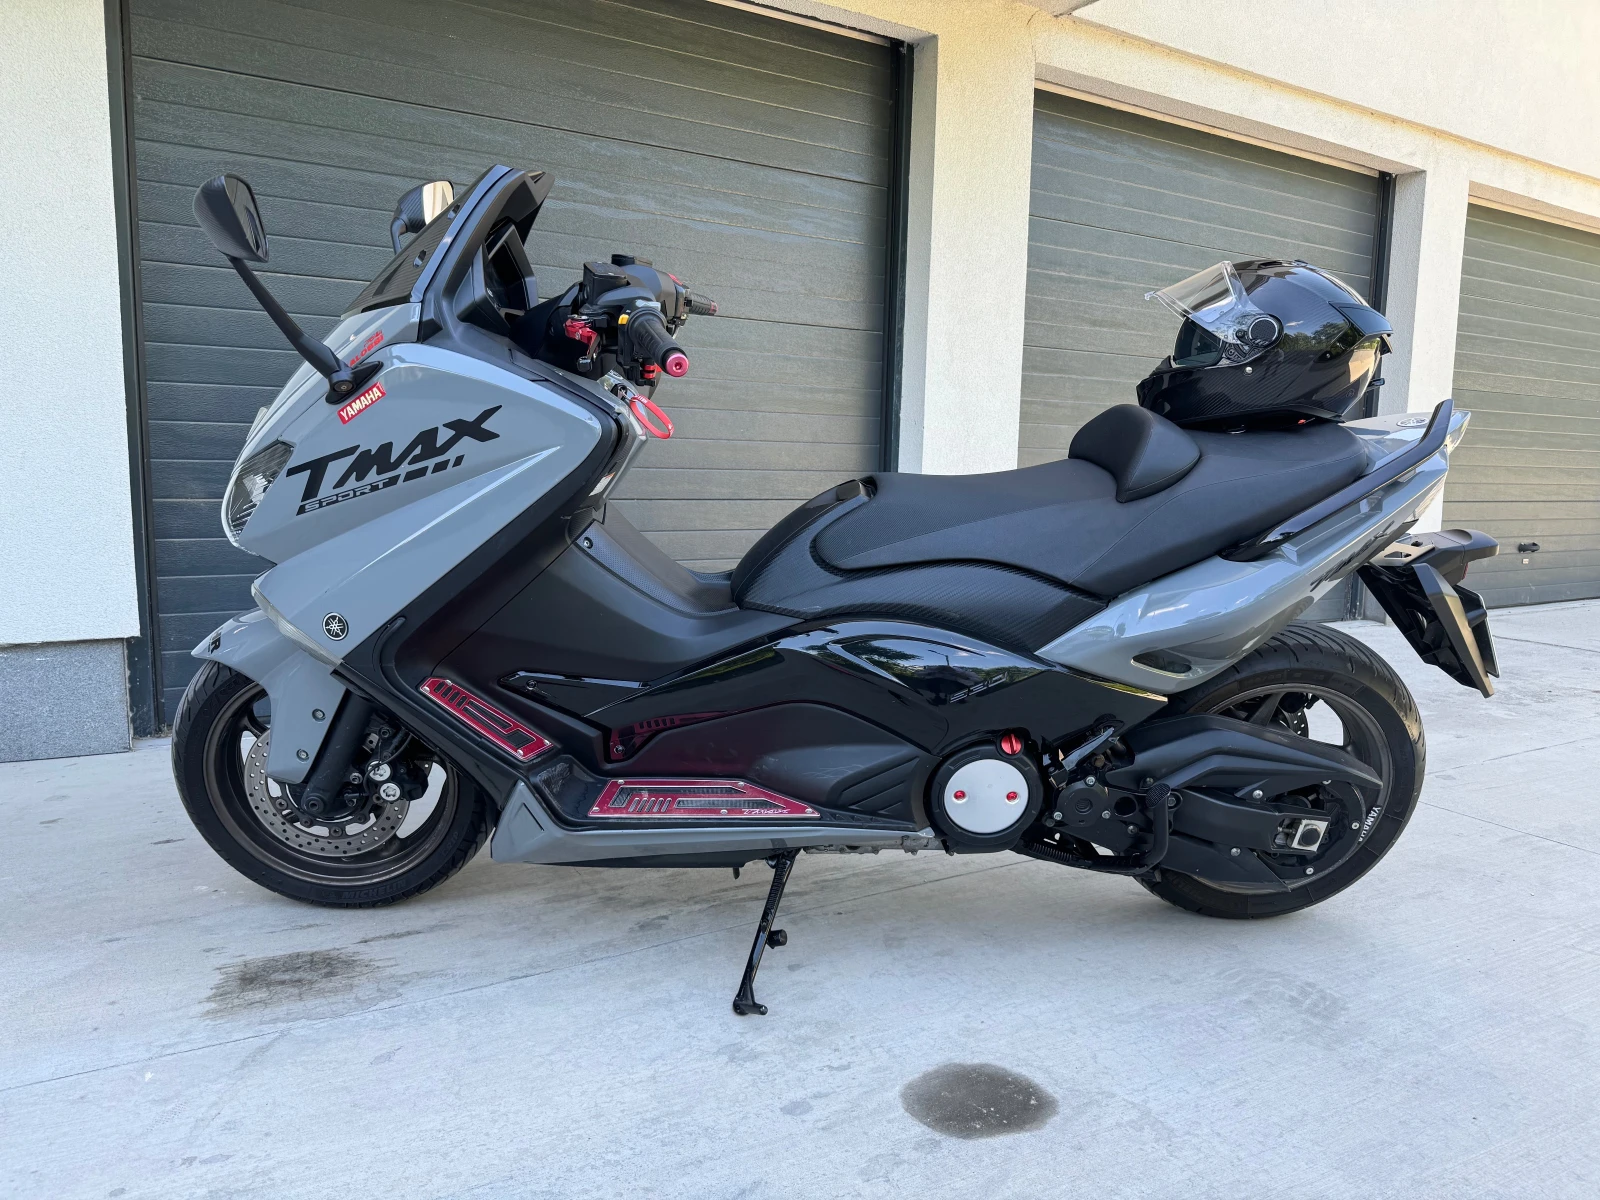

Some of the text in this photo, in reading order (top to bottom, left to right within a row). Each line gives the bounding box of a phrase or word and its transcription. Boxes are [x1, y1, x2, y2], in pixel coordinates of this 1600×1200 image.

[348, 334, 384, 367] ALOSSI
[340, 386, 382, 421] YAMAHA
[286, 405, 502, 502] TMAX
[304, 478, 390, 512] SPORT
[341, 878, 408, 900] MICHELIN
